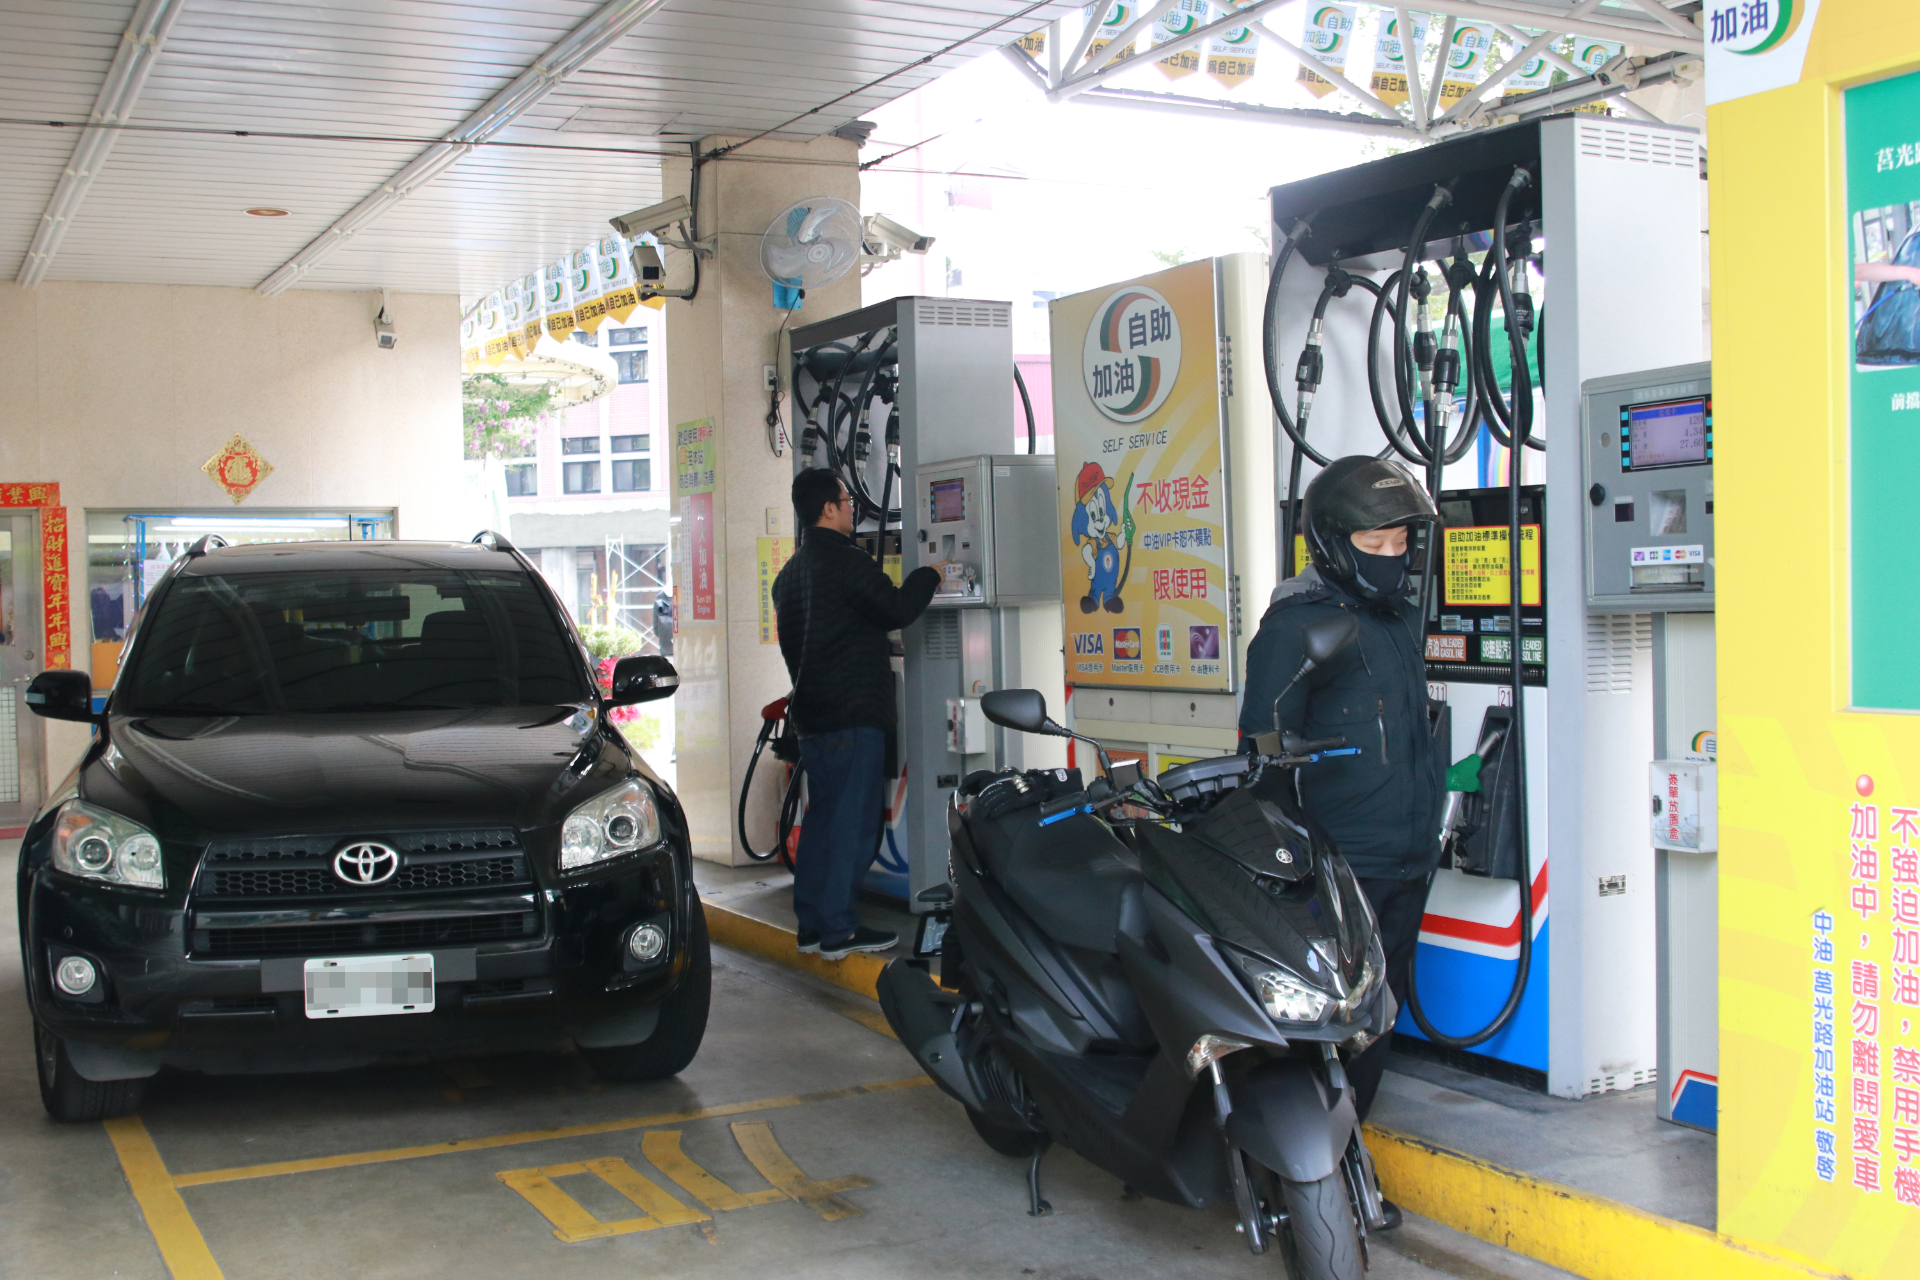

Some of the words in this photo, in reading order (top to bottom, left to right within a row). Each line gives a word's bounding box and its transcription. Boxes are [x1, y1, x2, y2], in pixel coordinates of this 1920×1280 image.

[1328, 16, 1352, 32] 自助
[1711, 0, 1768, 45] 加油
[1304, 29, 1328, 44] 加油
[1128, 305, 1171, 350] 自助
[1092, 358, 1135, 399] 加油
[1689, 415, 1703, 426] 120
[1103, 436, 1125, 454] SELF
[1129, 430, 1168, 449] SERVICE
[1684, 427, 1703, 437] 4.34
[1680, 438, 1704, 449] 27.60
[0, 486, 48, 505] 業興
[1136, 474, 1210, 515] 不收現金
[1143, 527, 1212, 551] 中油VIP卡恕不積點
[1449, 529, 1534, 543] 自助加油標準操流程
[44, 514, 68, 650] 招財進寶年年興
[1153, 567, 1207, 601] 限使用
[1072, 633, 1104, 655] VISA
[1115, 640, 1140, 649] MasterCard
[1440, 648, 1464, 659] GASOLINE
[1482, 639, 1511, 660] 98無鉛汽
[1521, 640, 1542, 650] LEADED
[1521, 651, 1542, 661] SOLINE
[1111, 663, 1145, 674] Master信用卡
[1153, 664, 1182, 674] JCB信用卡
[1706, 739, 1716, 753] 自
[1813, 912, 1833, 962] 中油
[1850, 803, 1881, 1192] 加油中，請勿離開愛車
[1890, 808, 1920, 1206] 不強迫加油，禁用手機
[1813, 971, 1834, 1123] 莒光路加油站
